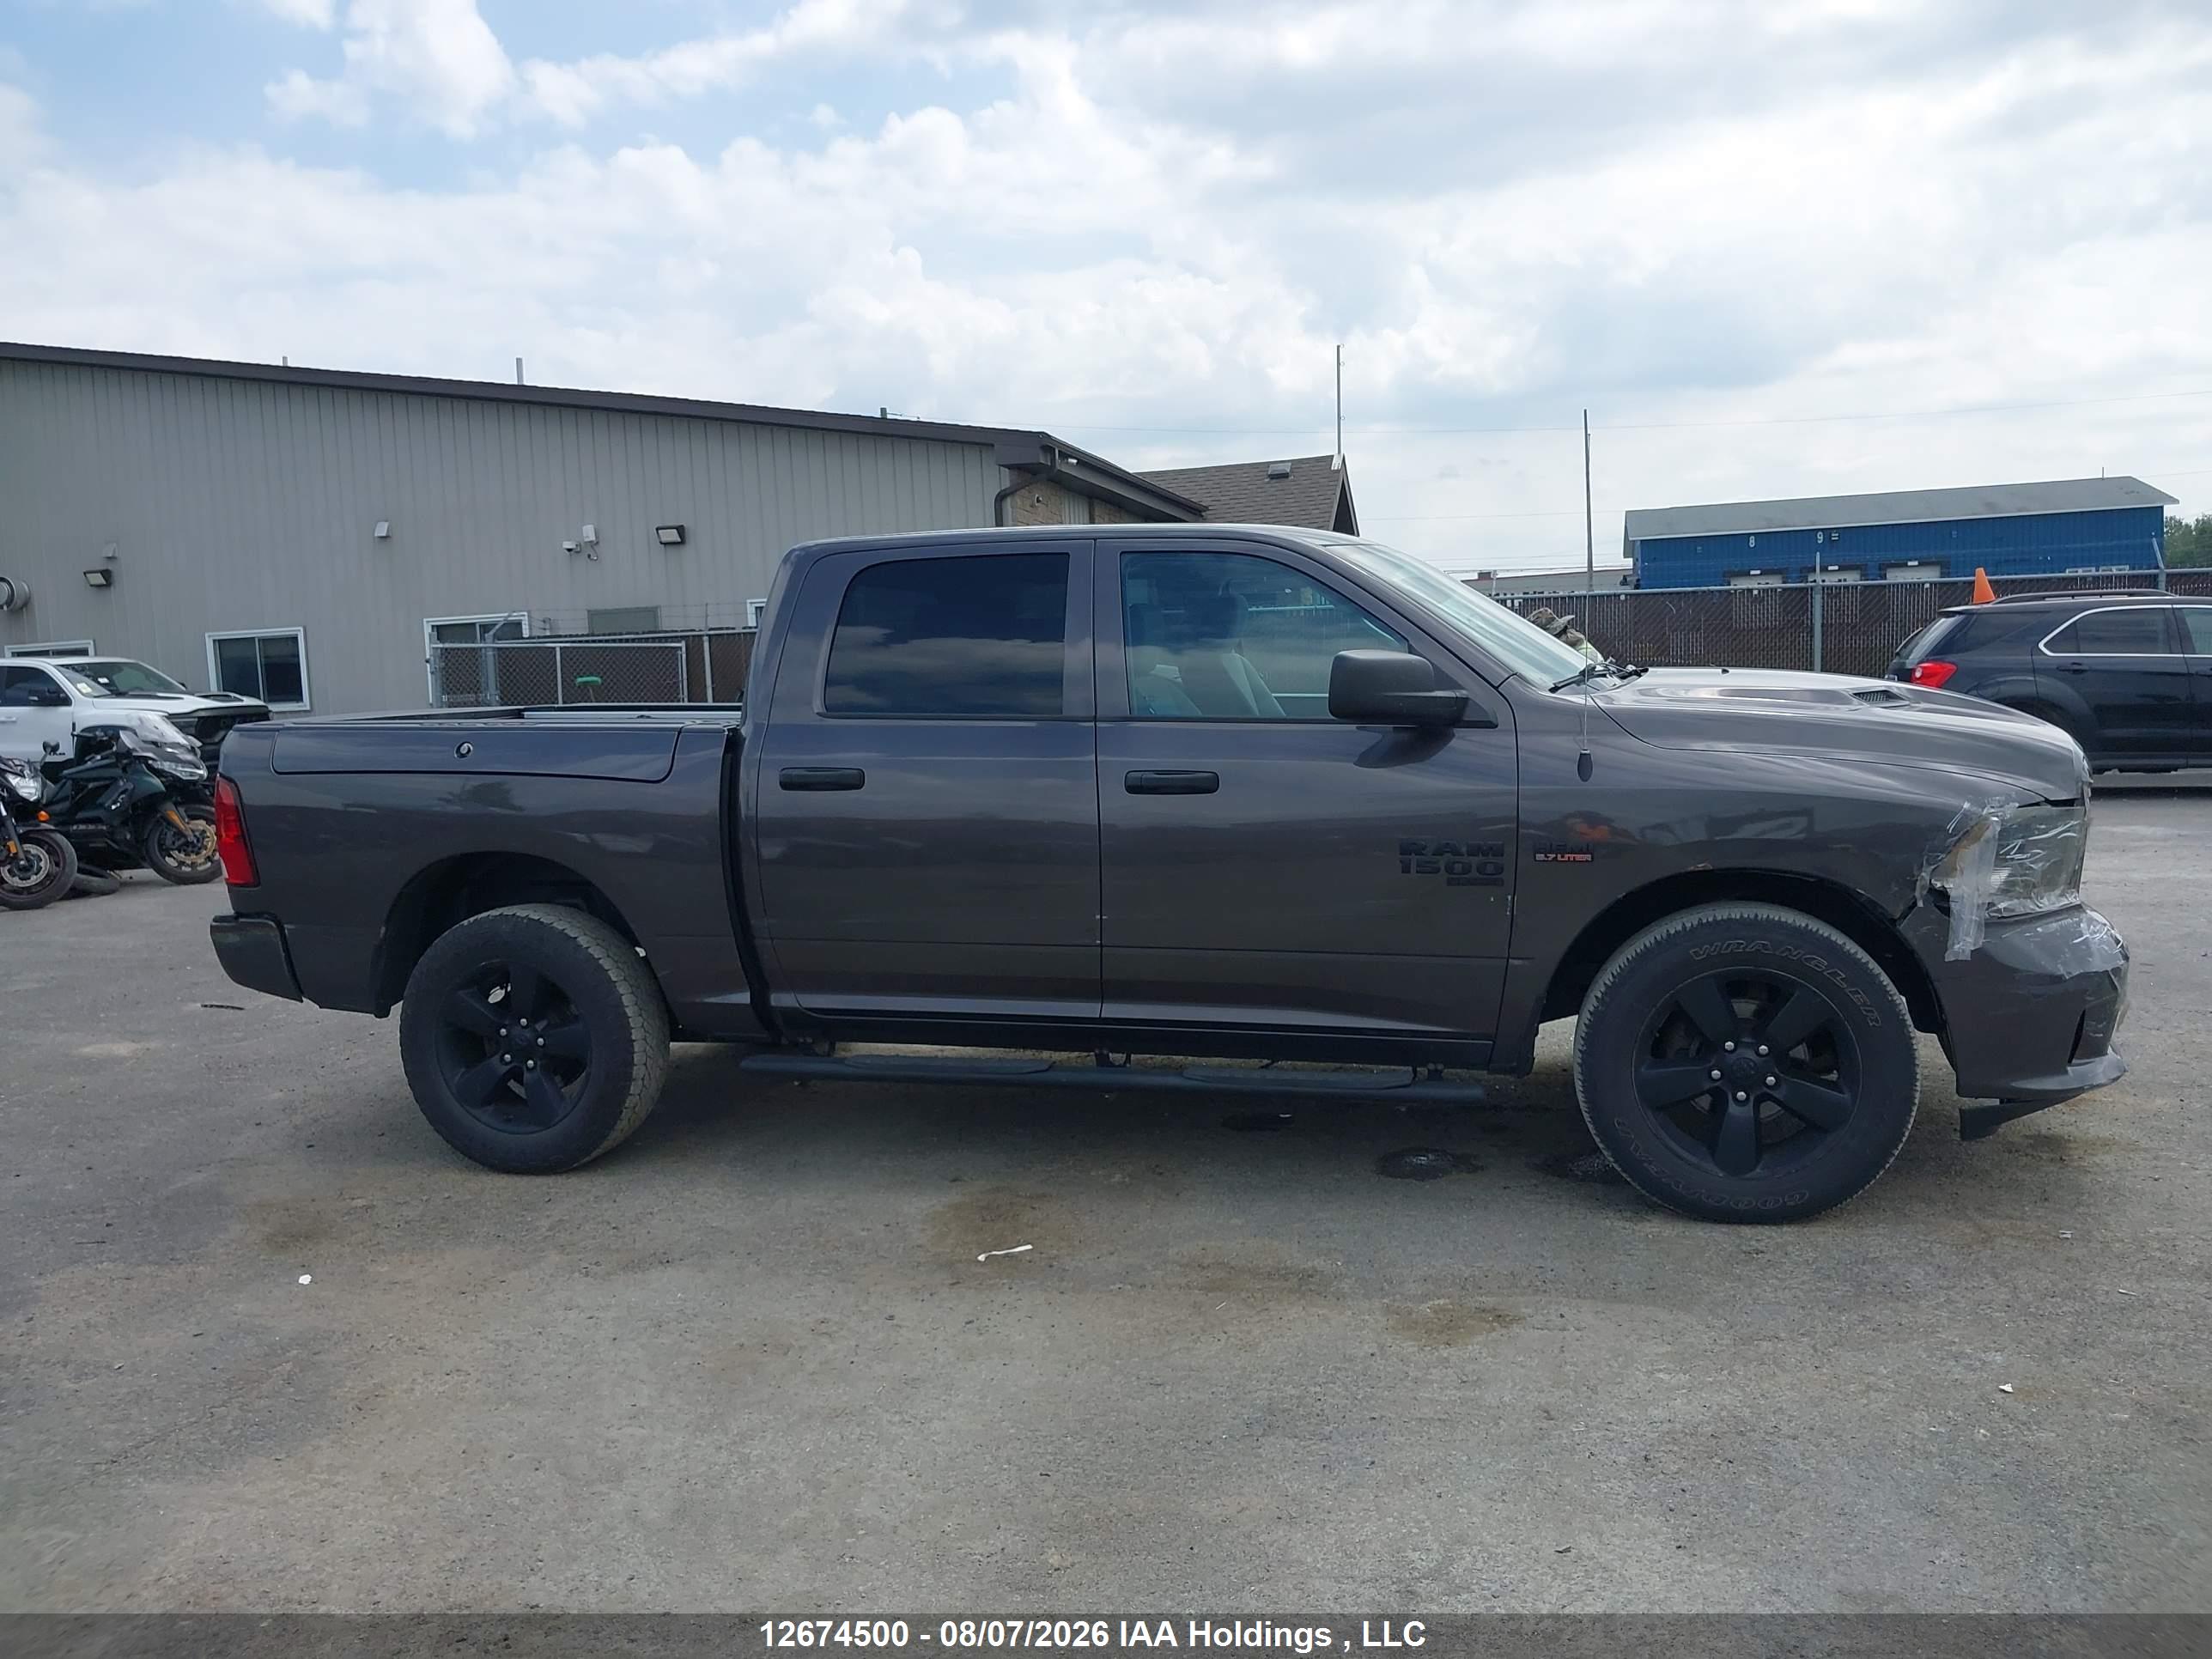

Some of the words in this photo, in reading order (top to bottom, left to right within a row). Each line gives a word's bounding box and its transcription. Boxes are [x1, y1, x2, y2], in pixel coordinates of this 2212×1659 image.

[1748, 535, 1756, 548] 8
[1816, 531, 1825, 544] 9
[1399, 841, 1505, 857] RAM
[1399, 860, 1505, 876] 1500
[1689, 940, 1882, 1028] WRANGLER
